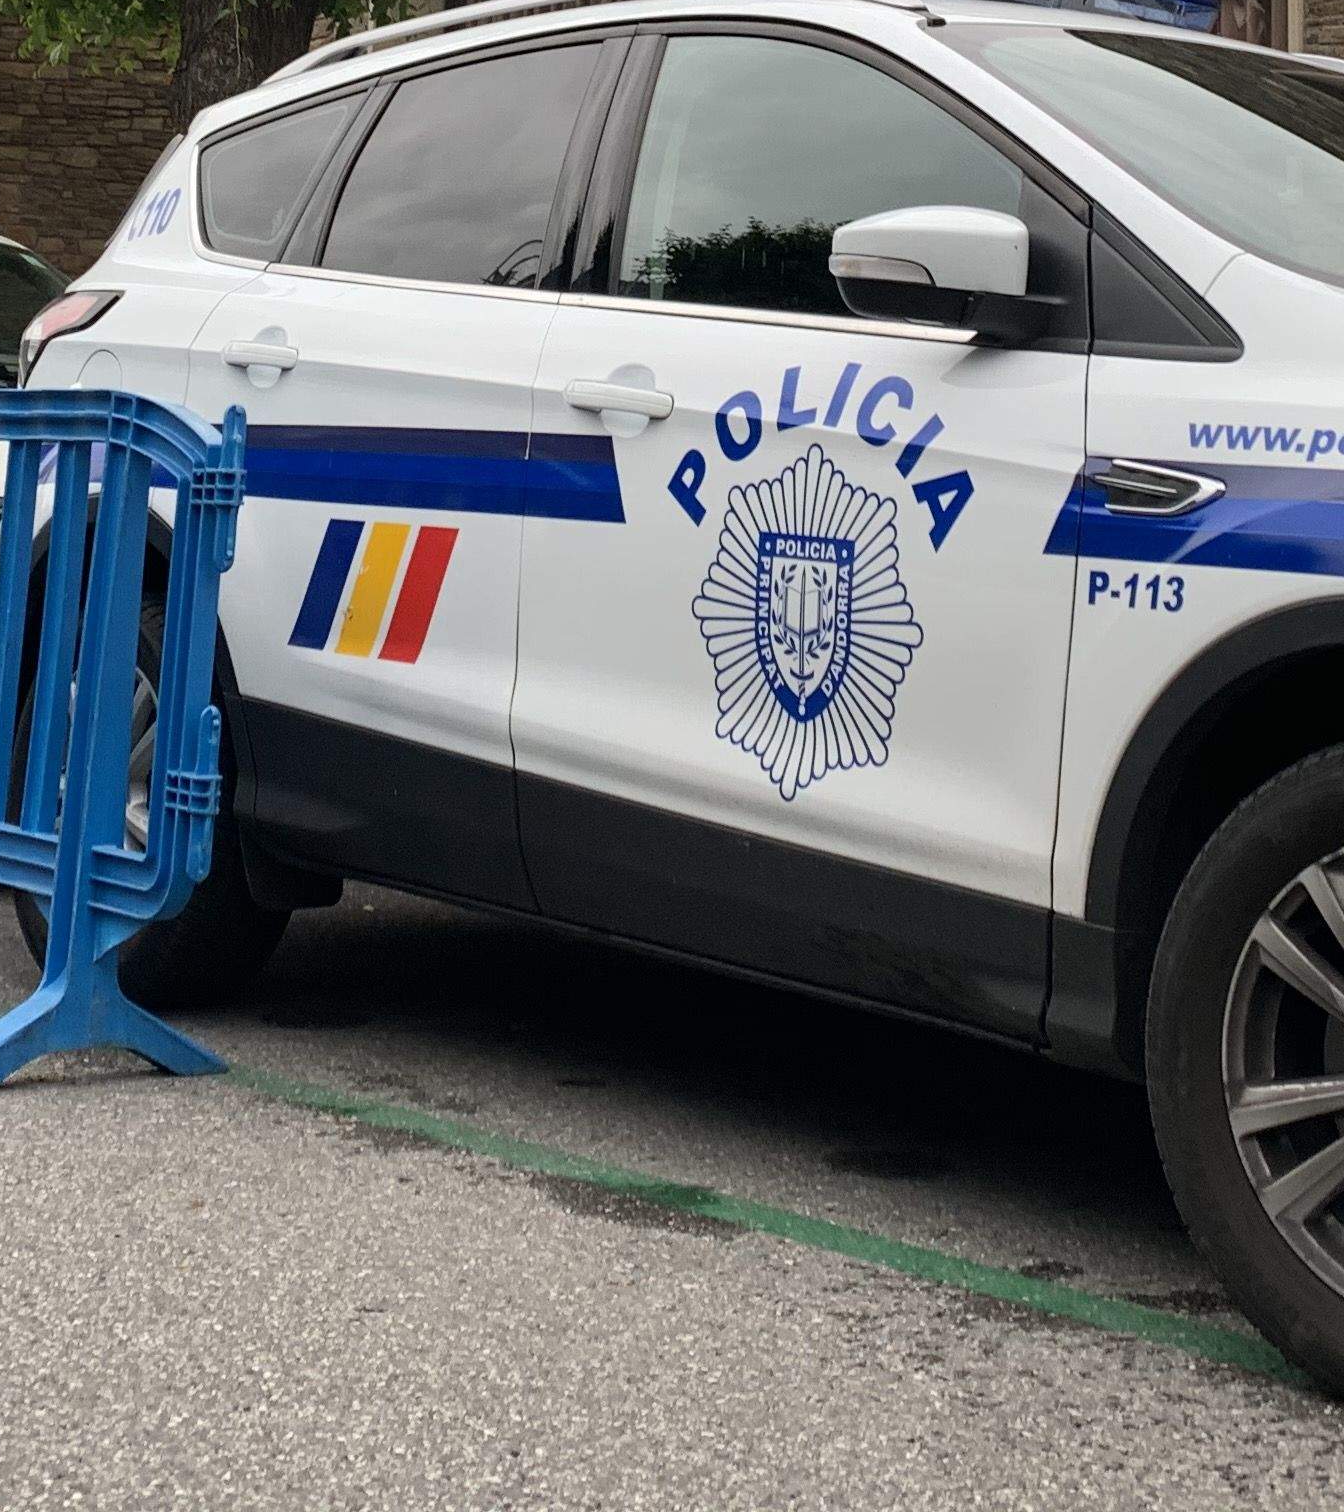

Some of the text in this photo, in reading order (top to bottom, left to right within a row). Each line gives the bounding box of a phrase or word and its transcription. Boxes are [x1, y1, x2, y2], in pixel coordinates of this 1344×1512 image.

[667, 361, 975, 553] POLICIA
[775, 538, 837, 561] POLICIA
[1088, 571, 1185, 612] P-113
[758, 556, 785, 689] PRINCIPAT
[820, 564, 851, 698] D'ANDORRA
